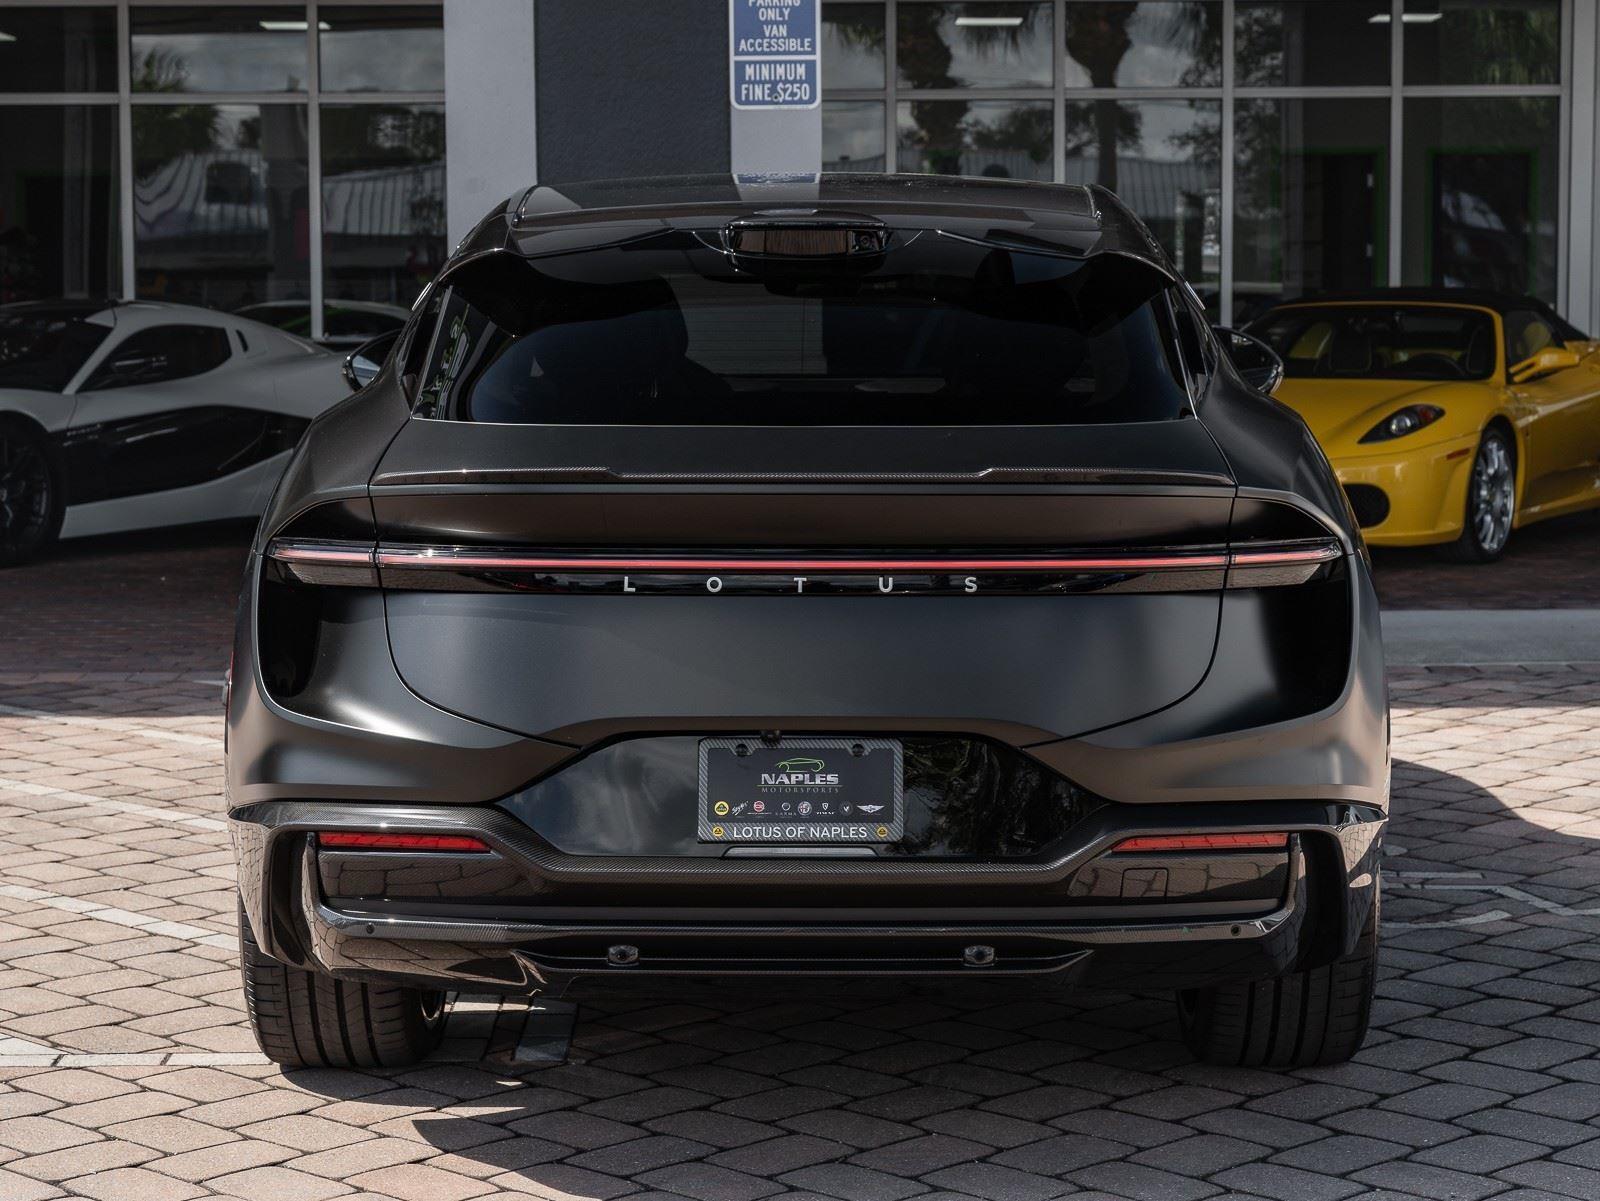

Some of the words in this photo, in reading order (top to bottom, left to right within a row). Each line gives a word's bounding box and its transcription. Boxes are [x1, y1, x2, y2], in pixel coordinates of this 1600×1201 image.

[758, 8, 791, 21] ONLY
[763, 24, 788, 37] VAN
[739, 38, 812, 52] ACCESSIBLE
[745, 63, 806, 81] MINIMUM
[741, 83, 772, 101] FINE
[777, 82, 810, 103] $250
[623, 576, 978, 593] LOTUS
[761, 773, 839, 785] NAPLES
[733, 826, 782, 838] LOTUS
[785, 826, 805, 838] OF
[810, 826, 868, 838] NAPLES
